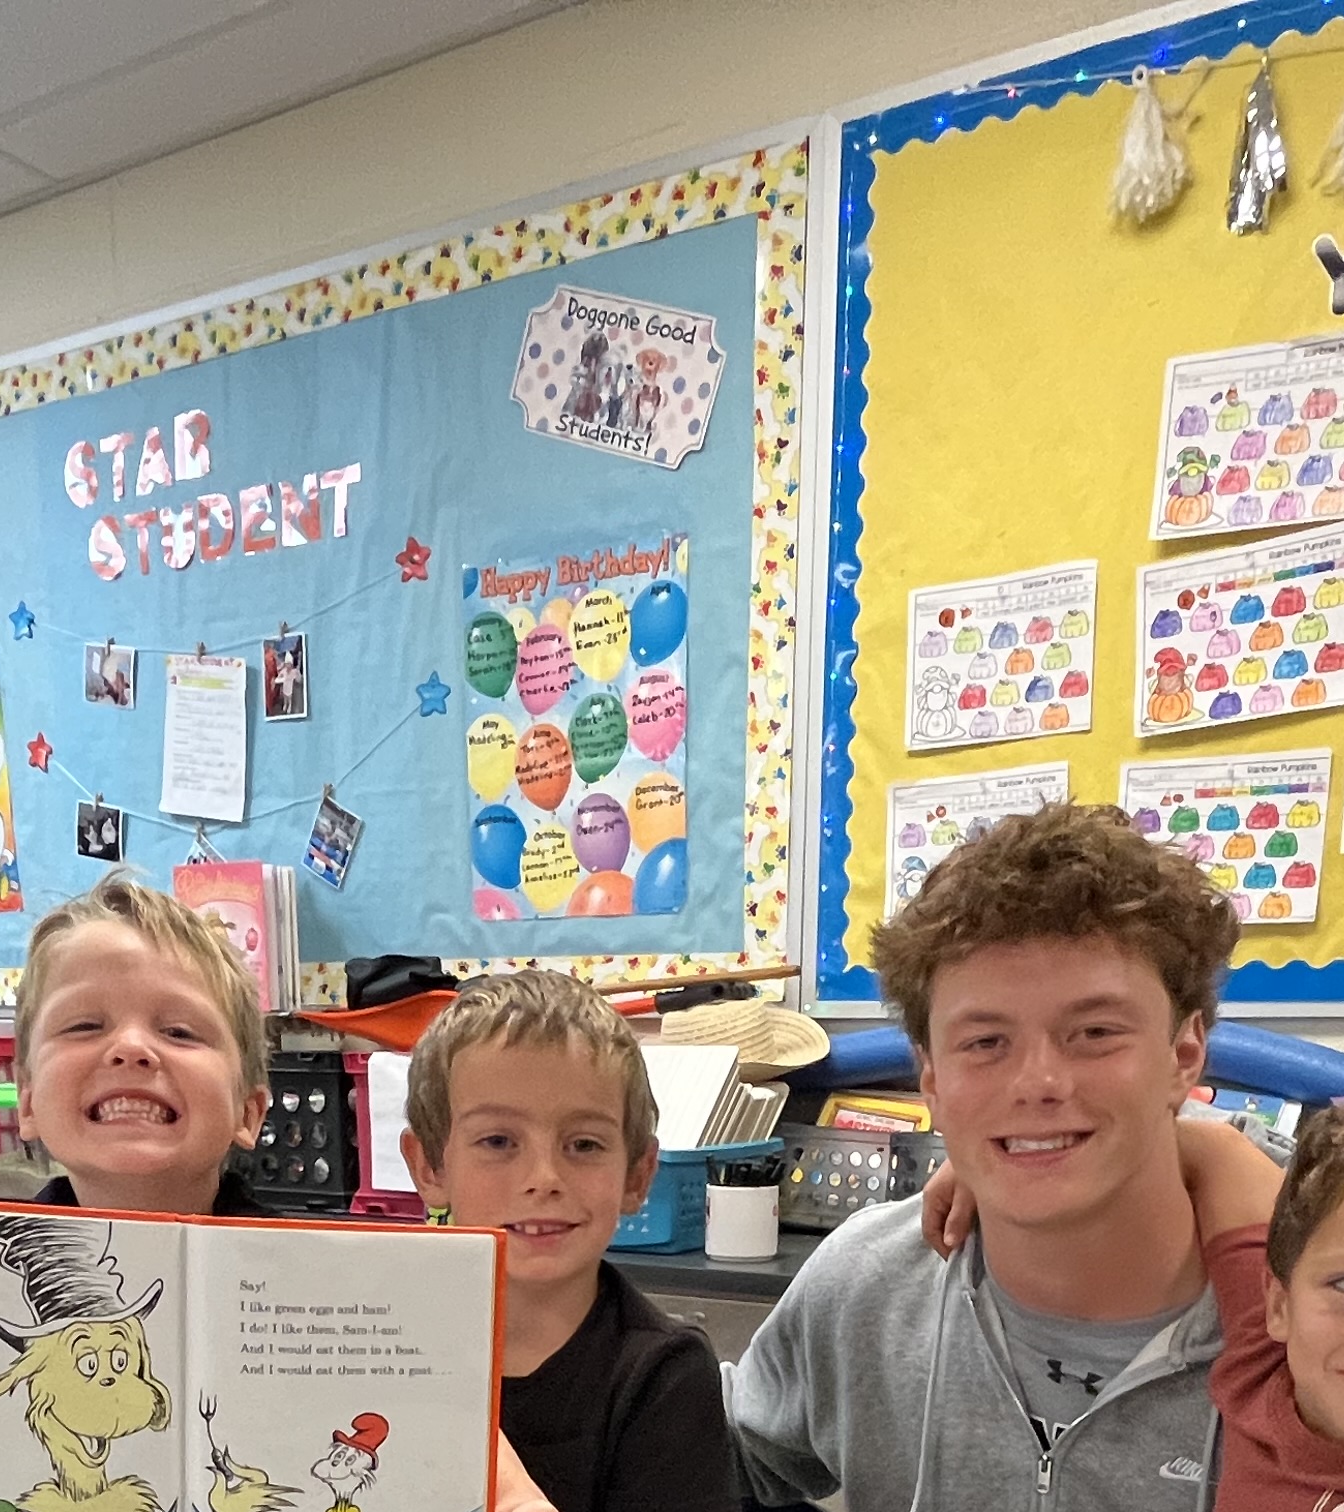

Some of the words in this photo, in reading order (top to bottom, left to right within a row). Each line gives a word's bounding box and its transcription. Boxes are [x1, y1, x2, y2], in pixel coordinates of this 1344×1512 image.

[568, 297, 640, 331] Doggone
[646, 314, 697, 345] Good
[555, 414, 652, 455] Students!
[88, 462, 362, 581] STUDENT
[480, 566, 551, 603] Happy
[557, 538, 671, 585] Birthday!
[585, 595, 613, 608] March
[240, 1280, 267, 1294] Say!
[240, 1301, 245, 1312] I
[249, 1302, 271, 1313] like
[337, 1303, 358, 1315] and
[362, 1304, 392, 1315] ham!
[240, 1323, 245, 1333] I
[272, 1323, 277, 1333] I
[281, 1324, 303, 1334] like
[240, 1344, 265, 1354] And
[269, 1344, 274, 1354] I
[278, 1344, 312, 1354] would
[316, 1346, 334, 1355] eat
[337, 1345, 367, 1355] them
[240, 1365, 265, 1375] And
[269, 1365, 274, 1375] I
[277, 1365, 312, 1375] would
[316, 1366, 333, 1375] eat
[337, 1365, 366, 1375] them
[370, 1366, 395, 1375] with
